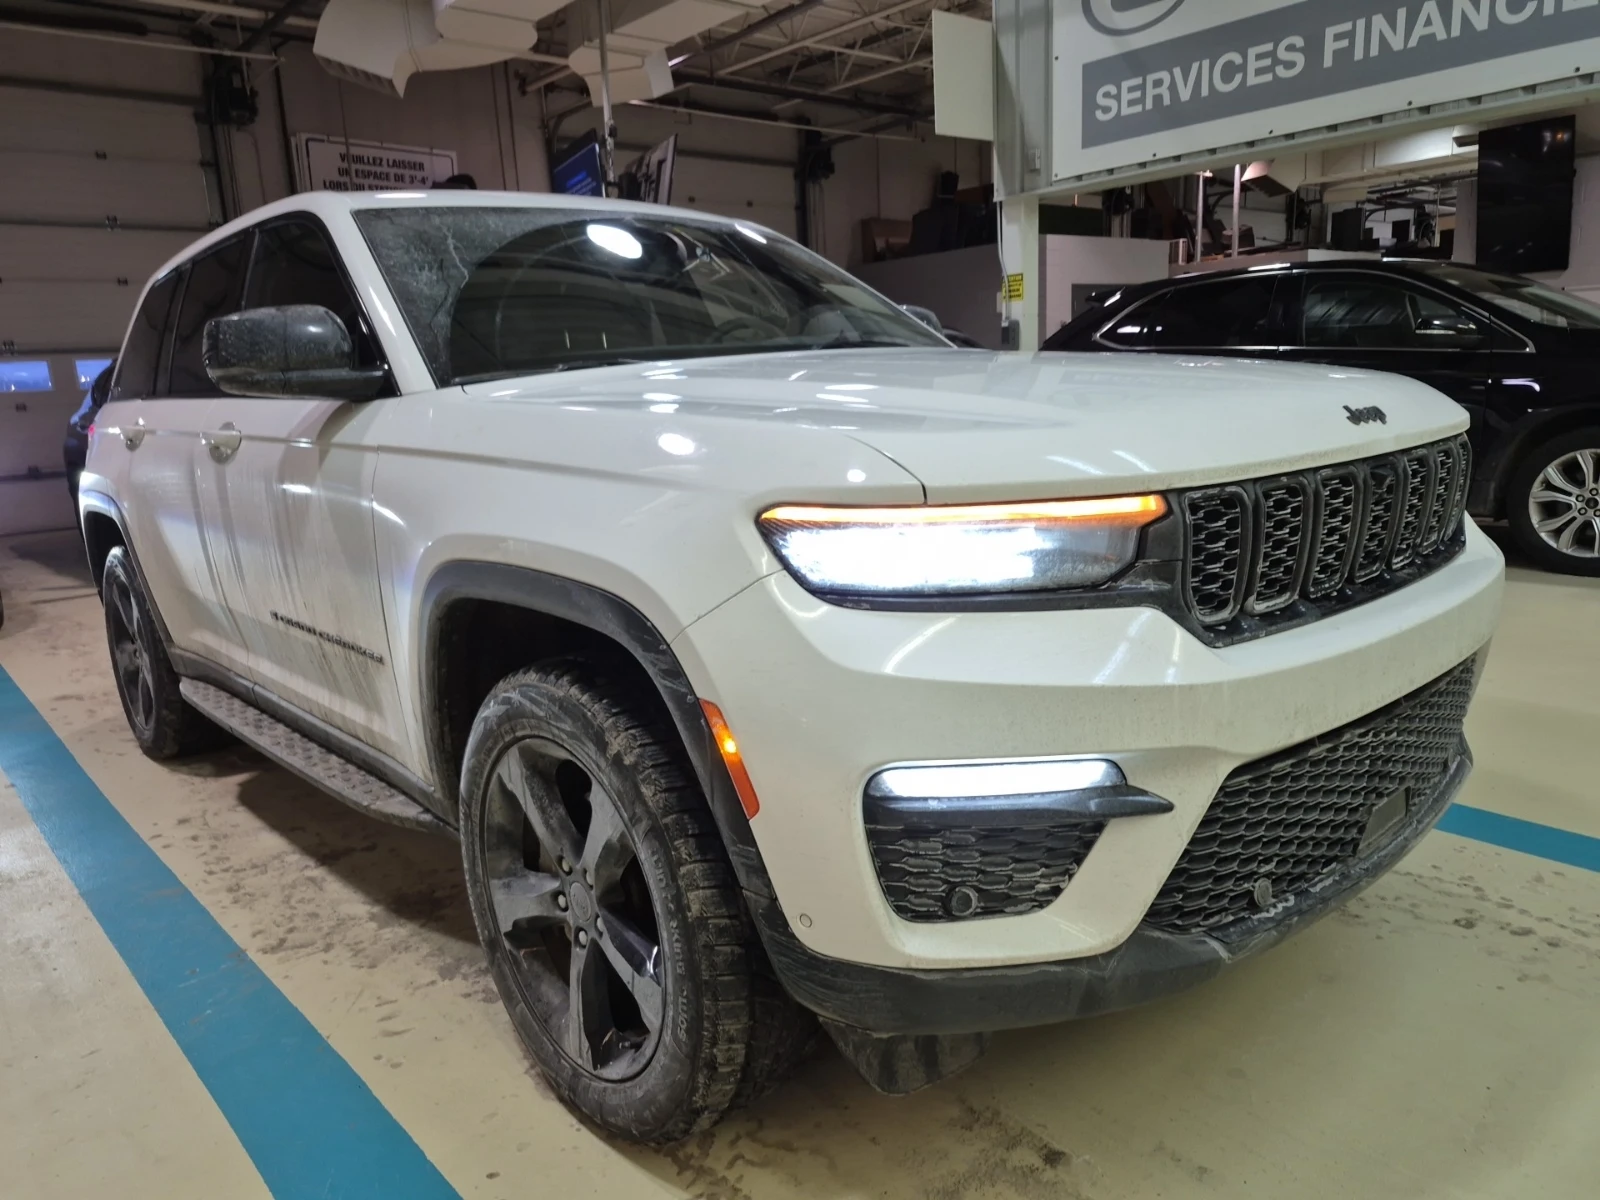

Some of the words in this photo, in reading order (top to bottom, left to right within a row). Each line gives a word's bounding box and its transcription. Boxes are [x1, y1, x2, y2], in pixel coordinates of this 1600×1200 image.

[1094, 35, 1305, 122] SERVICES
[1323, 0, 1599, 68] FINANC
[386, 158, 425, 172] LAISSER
[337, 167, 351, 177] UN
[354, 168, 392, 182] ESPACE
[393, 173, 406, 184] DE
[323, 180, 349, 192] LORS
[1342, 405, 1387, 426] Jeep
